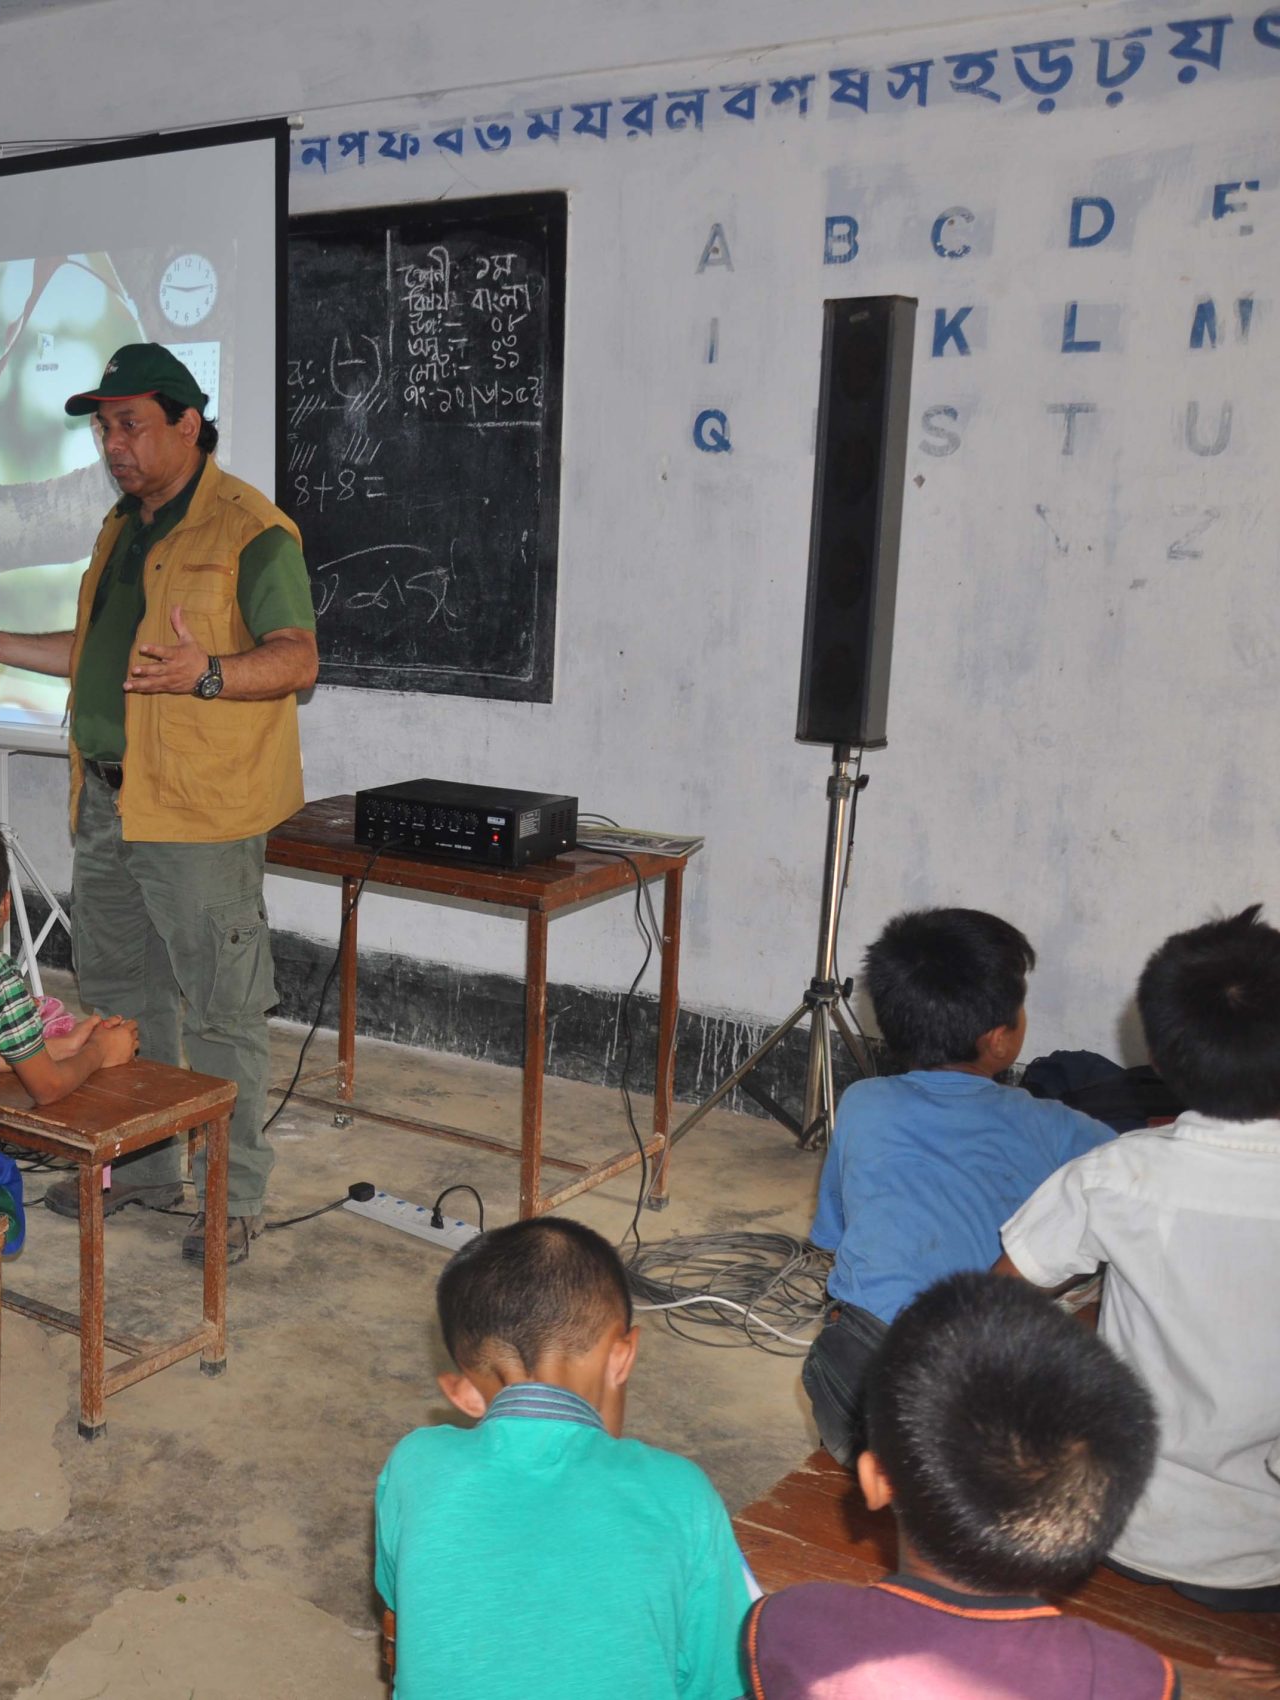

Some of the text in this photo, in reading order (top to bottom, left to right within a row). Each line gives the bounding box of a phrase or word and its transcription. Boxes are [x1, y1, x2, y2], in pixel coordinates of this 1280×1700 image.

[338, 131, 369, 165] প
[377, 125, 421, 162] ফ
[525, 107, 563, 142] ম
[571, 101, 612, 140] য
[621, 93, 659, 141] র
[665, 88, 710, 131] ল
[768, 73, 816, 118] শ
[887, 59, 935, 108] স
[945, 49, 1002, 103] হ
[695, 195, 1116, 275] A B C D
[932, 305, 975, 358] K
[1061, 300, 1102, 354] L
[692, 400, 1235, 458] Q S T U
